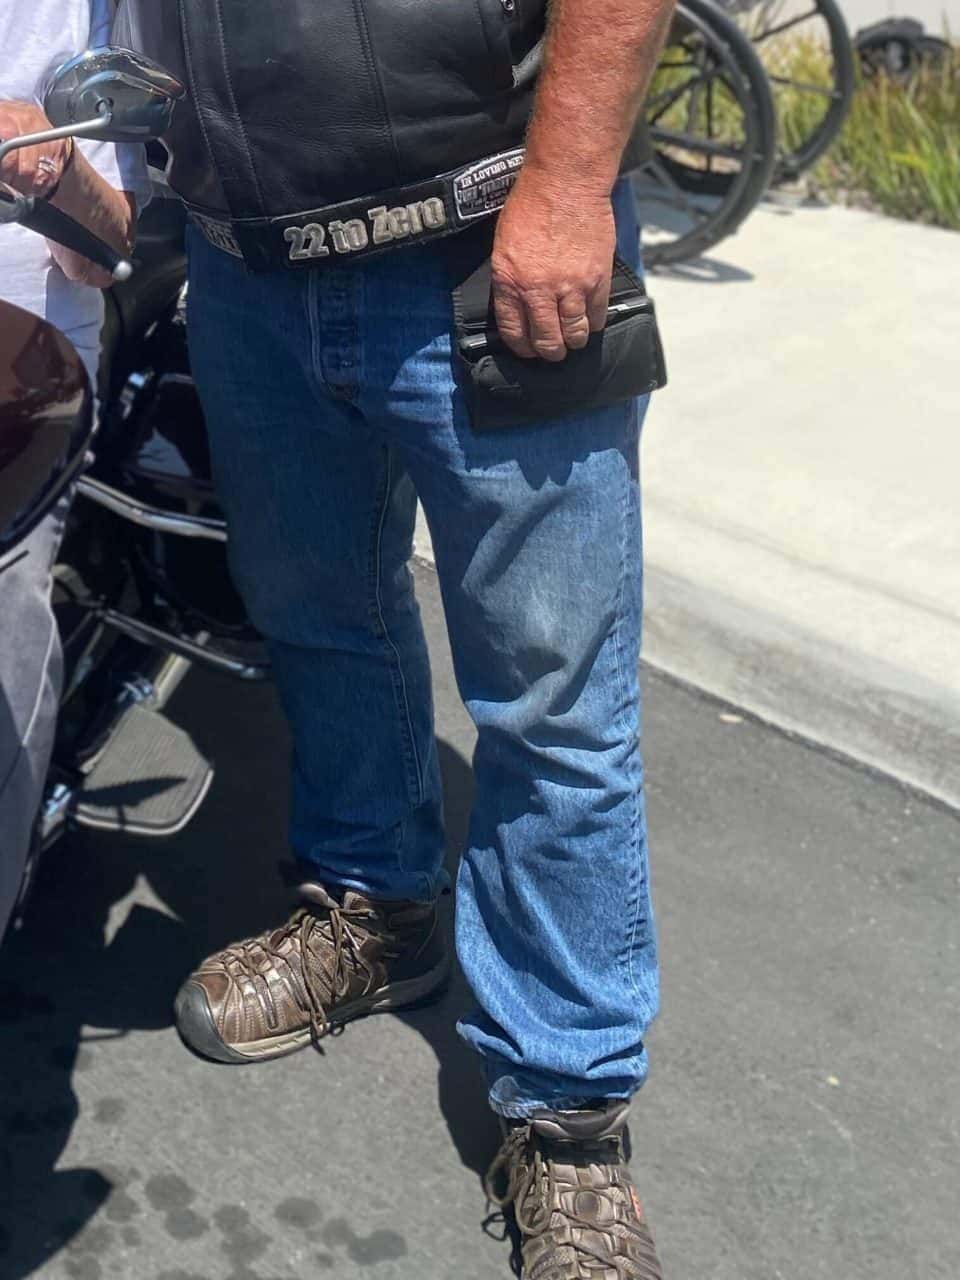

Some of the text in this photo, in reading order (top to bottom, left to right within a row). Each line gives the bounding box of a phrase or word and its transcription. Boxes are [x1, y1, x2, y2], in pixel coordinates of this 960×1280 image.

[461, 176, 473, 188] IN
[473, 160, 507, 182] LOVING
[284, 223, 330, 261] 22
[328, 219, 369, 254] to
[367, 197, 446, 246] Zero
